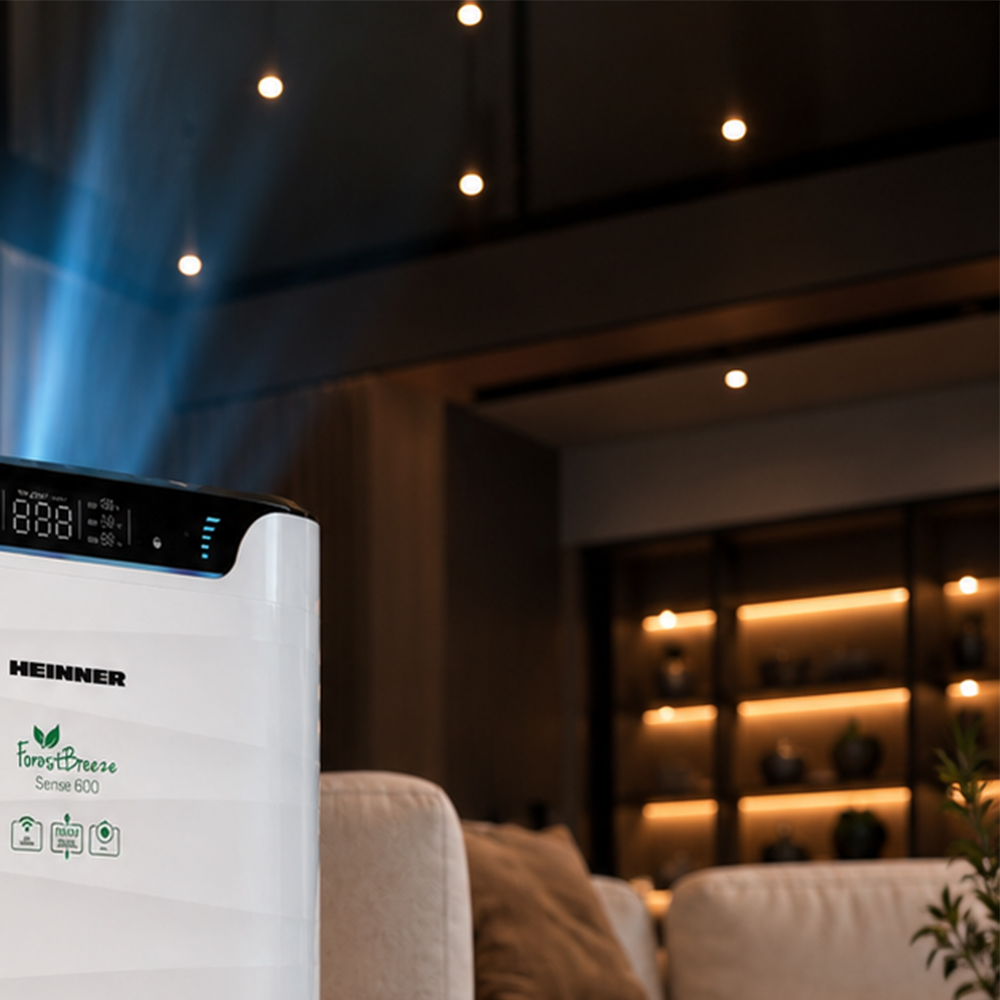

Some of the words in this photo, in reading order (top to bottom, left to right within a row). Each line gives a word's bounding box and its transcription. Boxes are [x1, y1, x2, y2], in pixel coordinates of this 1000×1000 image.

[9, 659, 126, 687] HEINNER
[35, 775, 72, 792] Sense
[74, 778, 100, 794] 600
